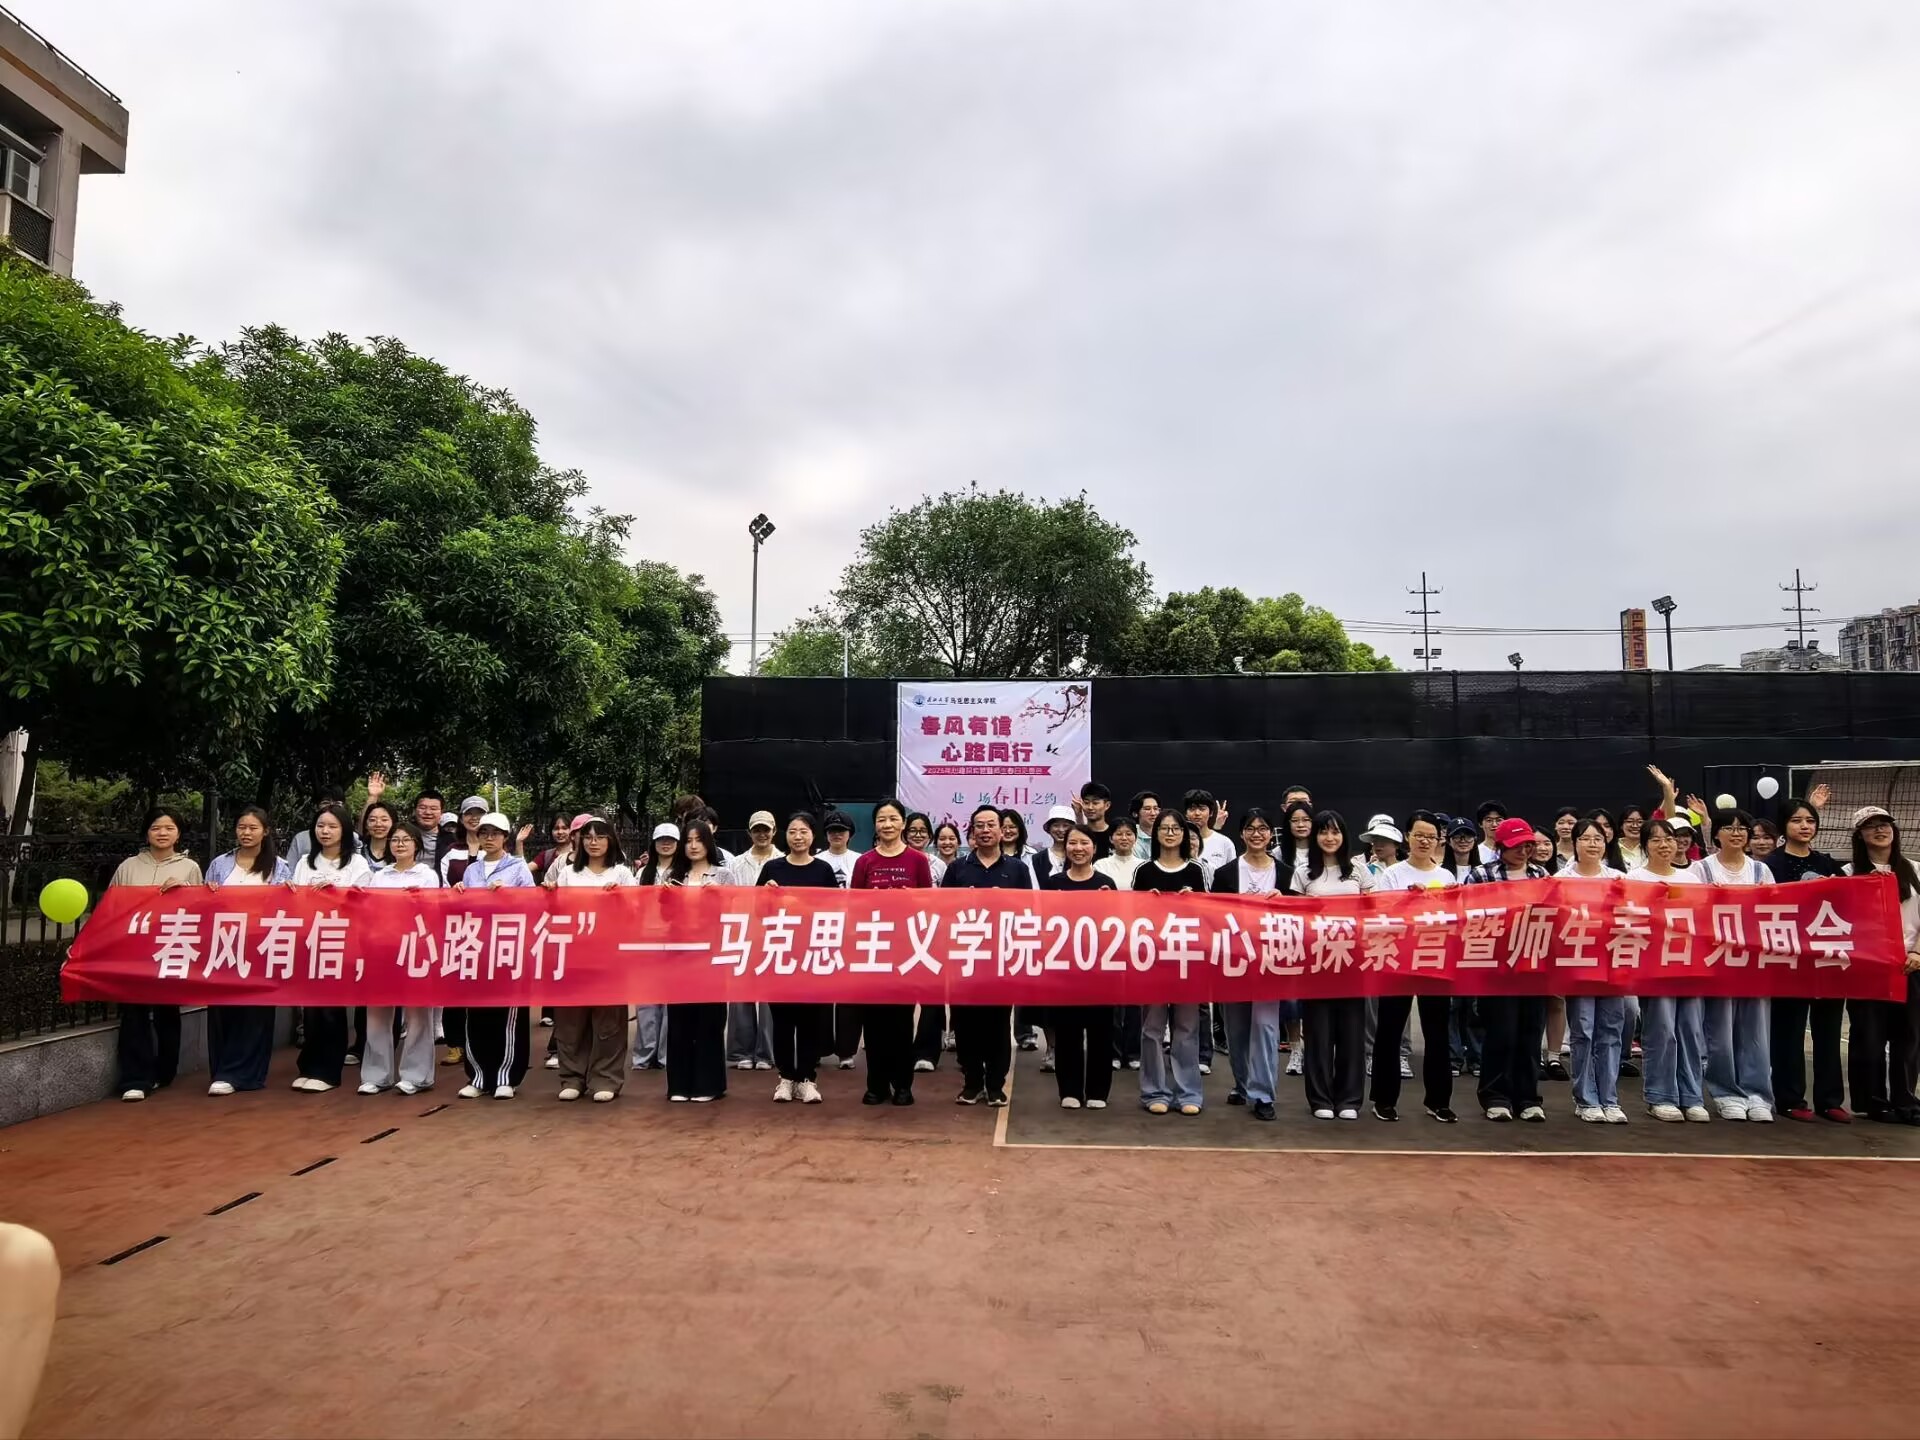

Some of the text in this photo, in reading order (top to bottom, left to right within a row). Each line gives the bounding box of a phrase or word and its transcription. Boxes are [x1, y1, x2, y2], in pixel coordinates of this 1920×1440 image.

[921, 716, 1012, 736] 春风有信
[941, 742, 1033, 762] 心路同行
